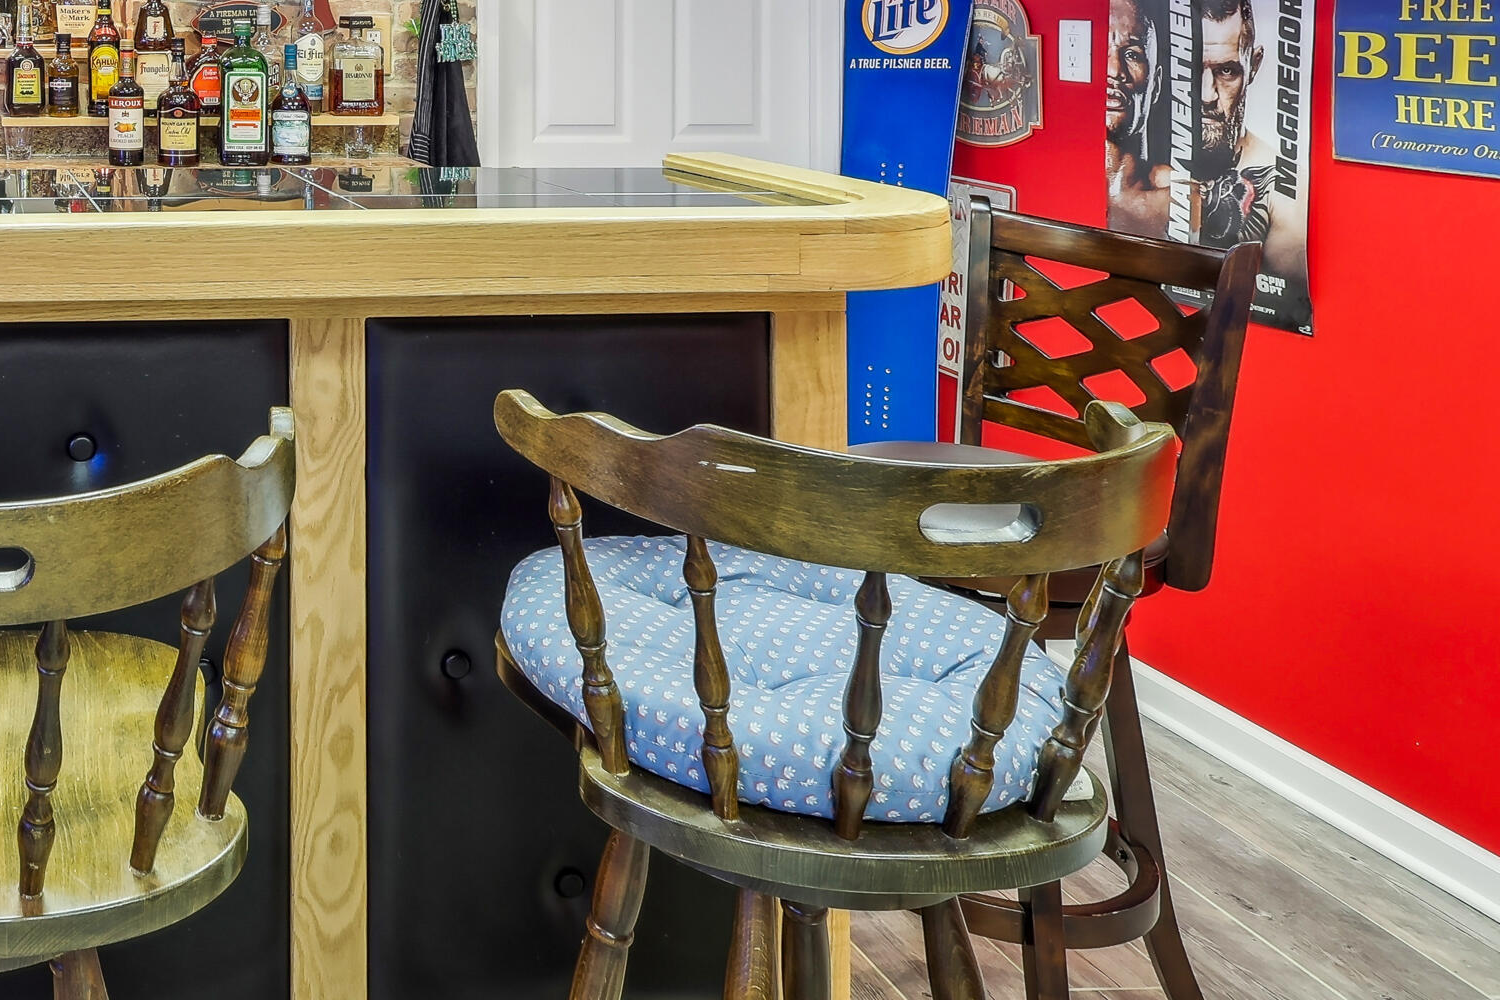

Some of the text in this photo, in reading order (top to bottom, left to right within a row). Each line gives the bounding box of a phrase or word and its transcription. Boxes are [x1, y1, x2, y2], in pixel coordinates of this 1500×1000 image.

[850, 58, 951, 69] A TRUE PILSNER BEER.
[1338, 31, 1499, 87] BEE
[956, 103, 1023, 137] REMAN
[1394, 95, 1496, 131] HERE
[1371, 131, 1469, 157] (Tomorrow
[1256, 274, 1286, 293] 6 PM
[1270, 286, 1283, 296] PT
